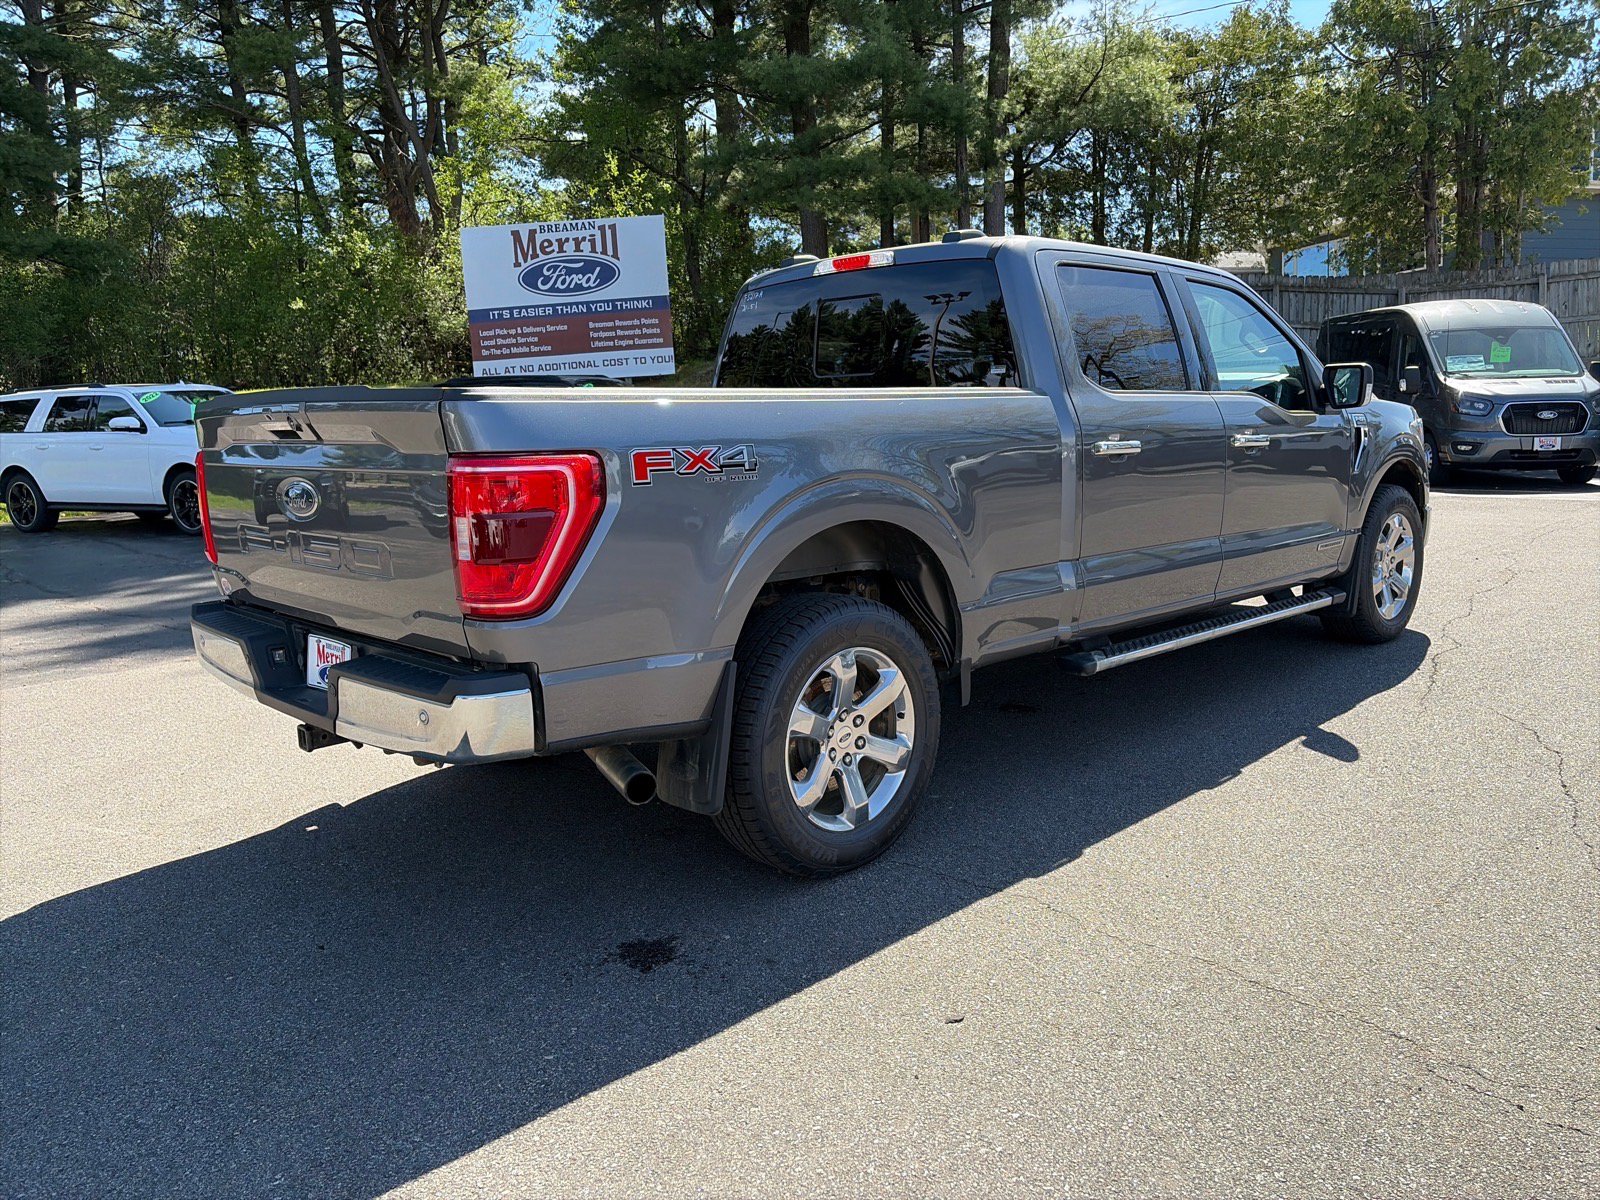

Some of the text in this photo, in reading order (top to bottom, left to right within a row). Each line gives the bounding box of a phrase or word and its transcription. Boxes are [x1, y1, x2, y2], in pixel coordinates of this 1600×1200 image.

[539, 221, 596, 234] BREAMAN
[510, 223, 621, 268] Merrill
[537, 262, 601, 290] Ford
[489, 299, 653, 320] IT'S EASIER THAN YOU THINK!
[588, 317, 659, 329] Breaman Rewards Points
[479, 328, 494, 337] Local
[495, 327, 516, 336] Pick-up
[522, 325, 546, 333] Delivery
[546, 324, 568, 332] Service
[616, 328, 641, 336] Rewards
[517, 336, 539, 344] Service
[590, 337, 664, 348] Lifetime Engine Guarantee
[510, 346, 530, 354] Mobile
[481, 354, 674, 377] ALL AT NO ADDITIONAL COST TO YOU!
[628, 443, 759, 487] FX4
[704, 474, 759, 484] OFF ROAD
[236, 522, 394, 579] F-150
[316, 642, 346, 667] Merrill
